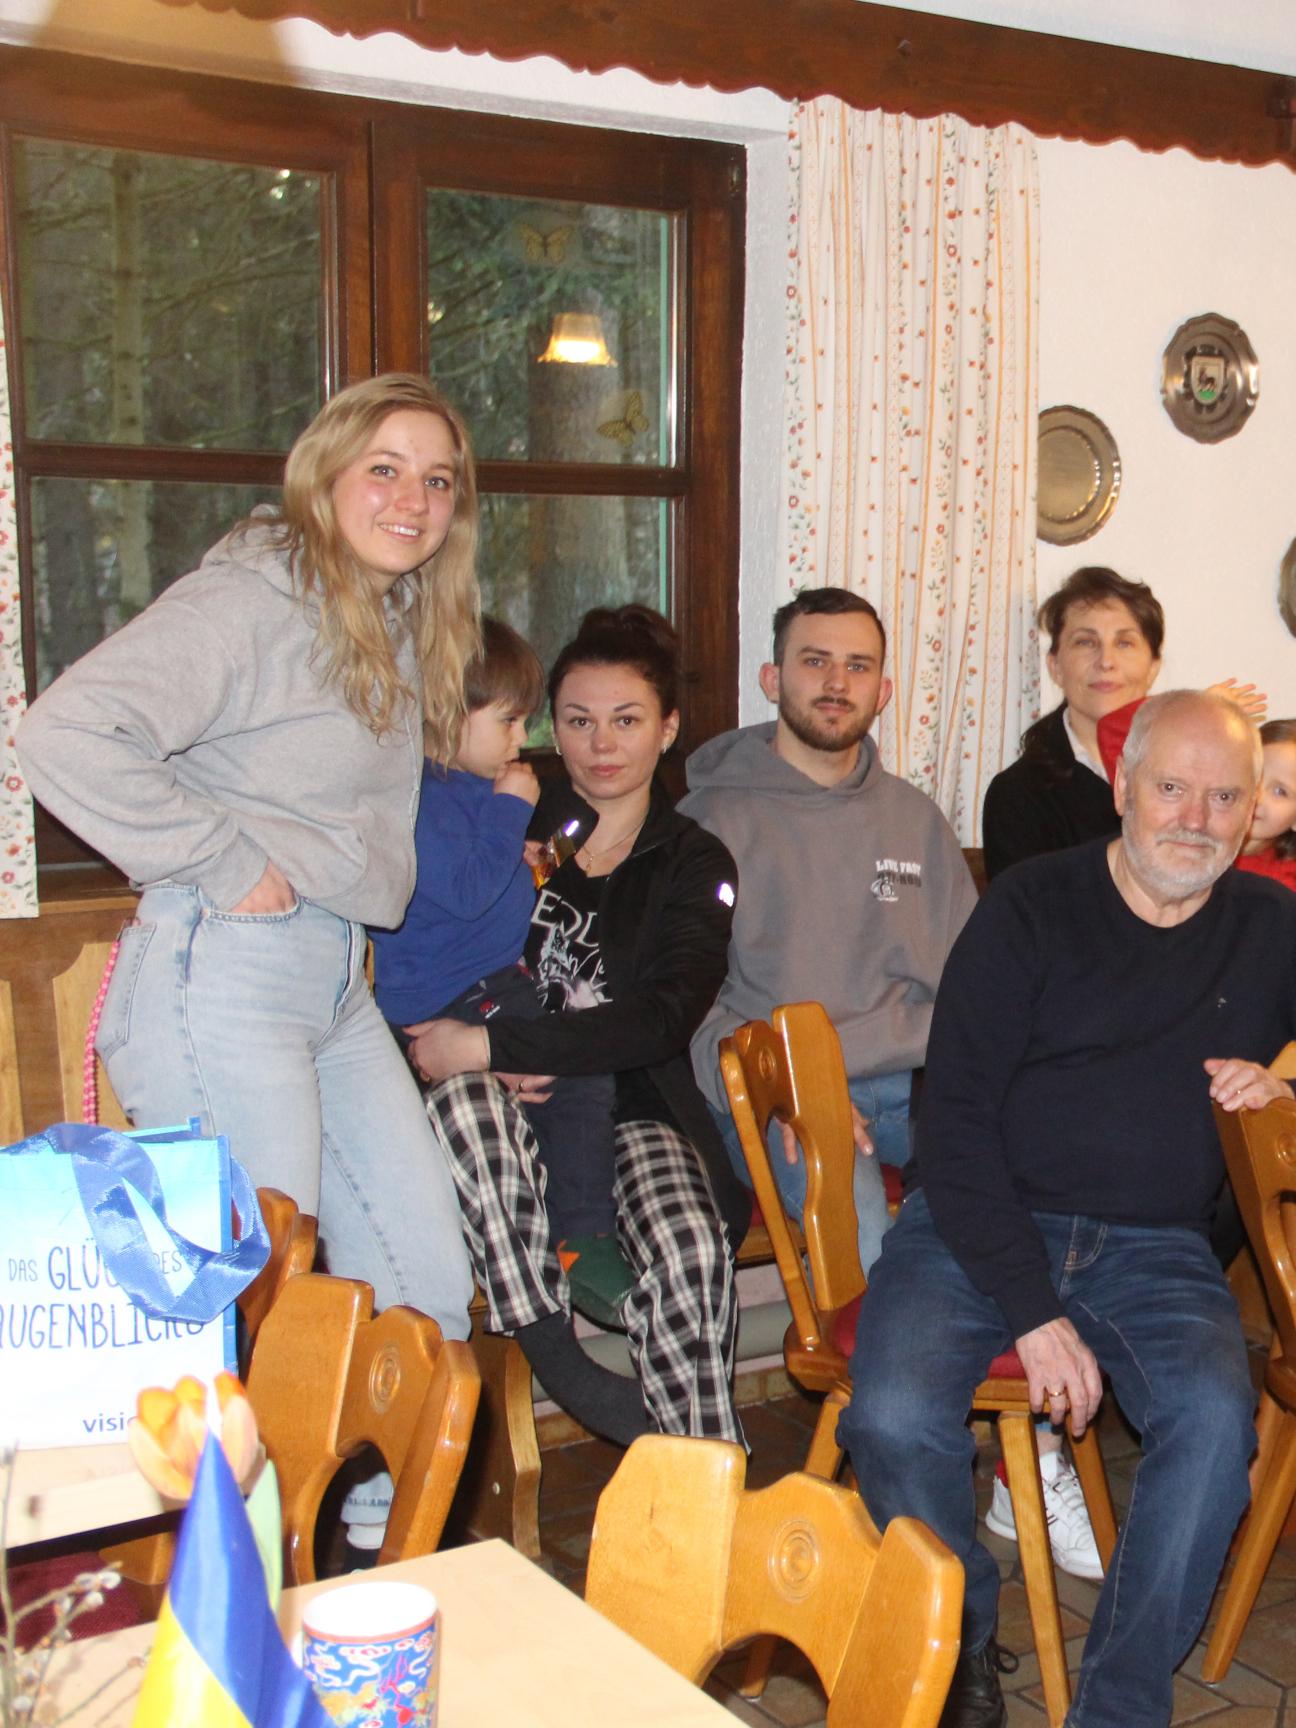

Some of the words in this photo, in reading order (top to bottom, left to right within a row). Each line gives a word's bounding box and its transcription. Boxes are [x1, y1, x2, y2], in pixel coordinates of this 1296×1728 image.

[8, 1257, 39, 1283] DAS
[48, 1237, 121, 1291] GLÜ
[82, 1411, 137, 1433] visi
